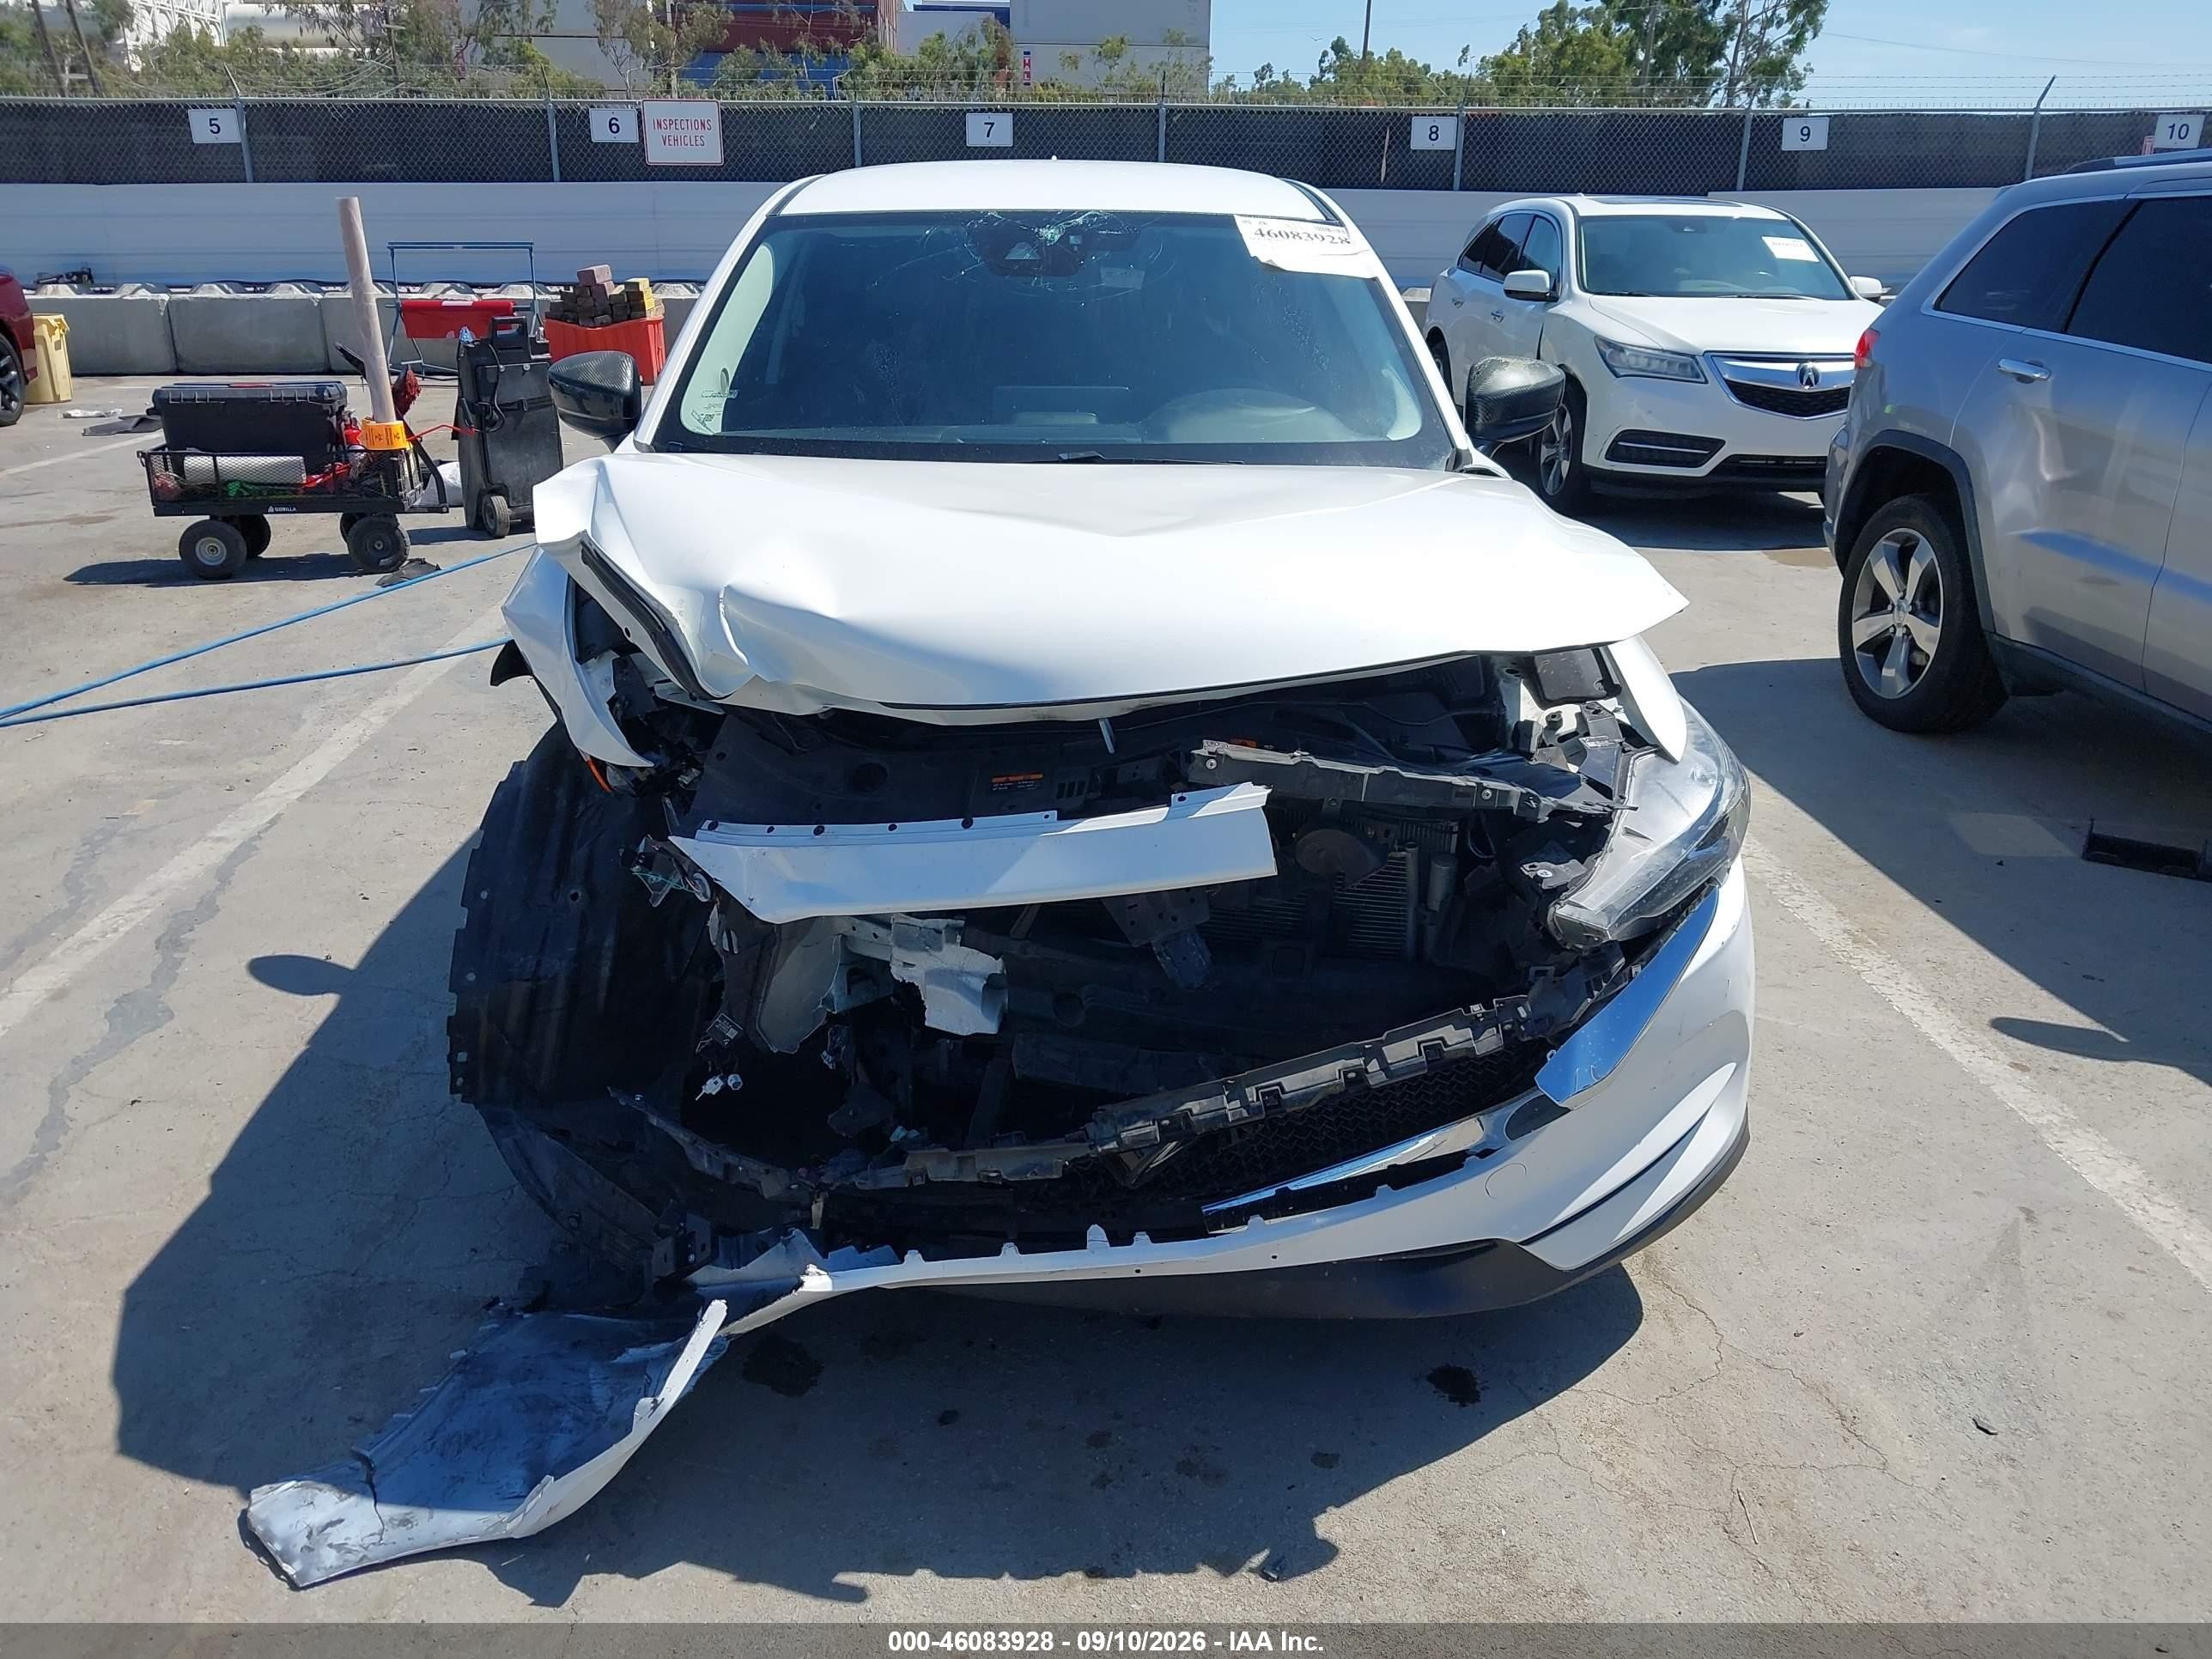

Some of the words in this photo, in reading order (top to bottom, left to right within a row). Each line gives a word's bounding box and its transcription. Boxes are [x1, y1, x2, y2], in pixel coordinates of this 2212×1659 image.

[1023, 57, 1031, 80] TAL
[209, 118, 221, 135] 5
[608, 117, 620, 134] 6
[653, 118, 712, 131] INSPECTIONS
[983, 122, 995, 138] 7
[2167, 123, 2190, 140] 10
[661, 135, 705, 147] VEHICLES
[1428, 125, 1439, 142] 8
[1799, 125, 1811, 143] 9
[1254, 228, 1351, 245] 46083928
